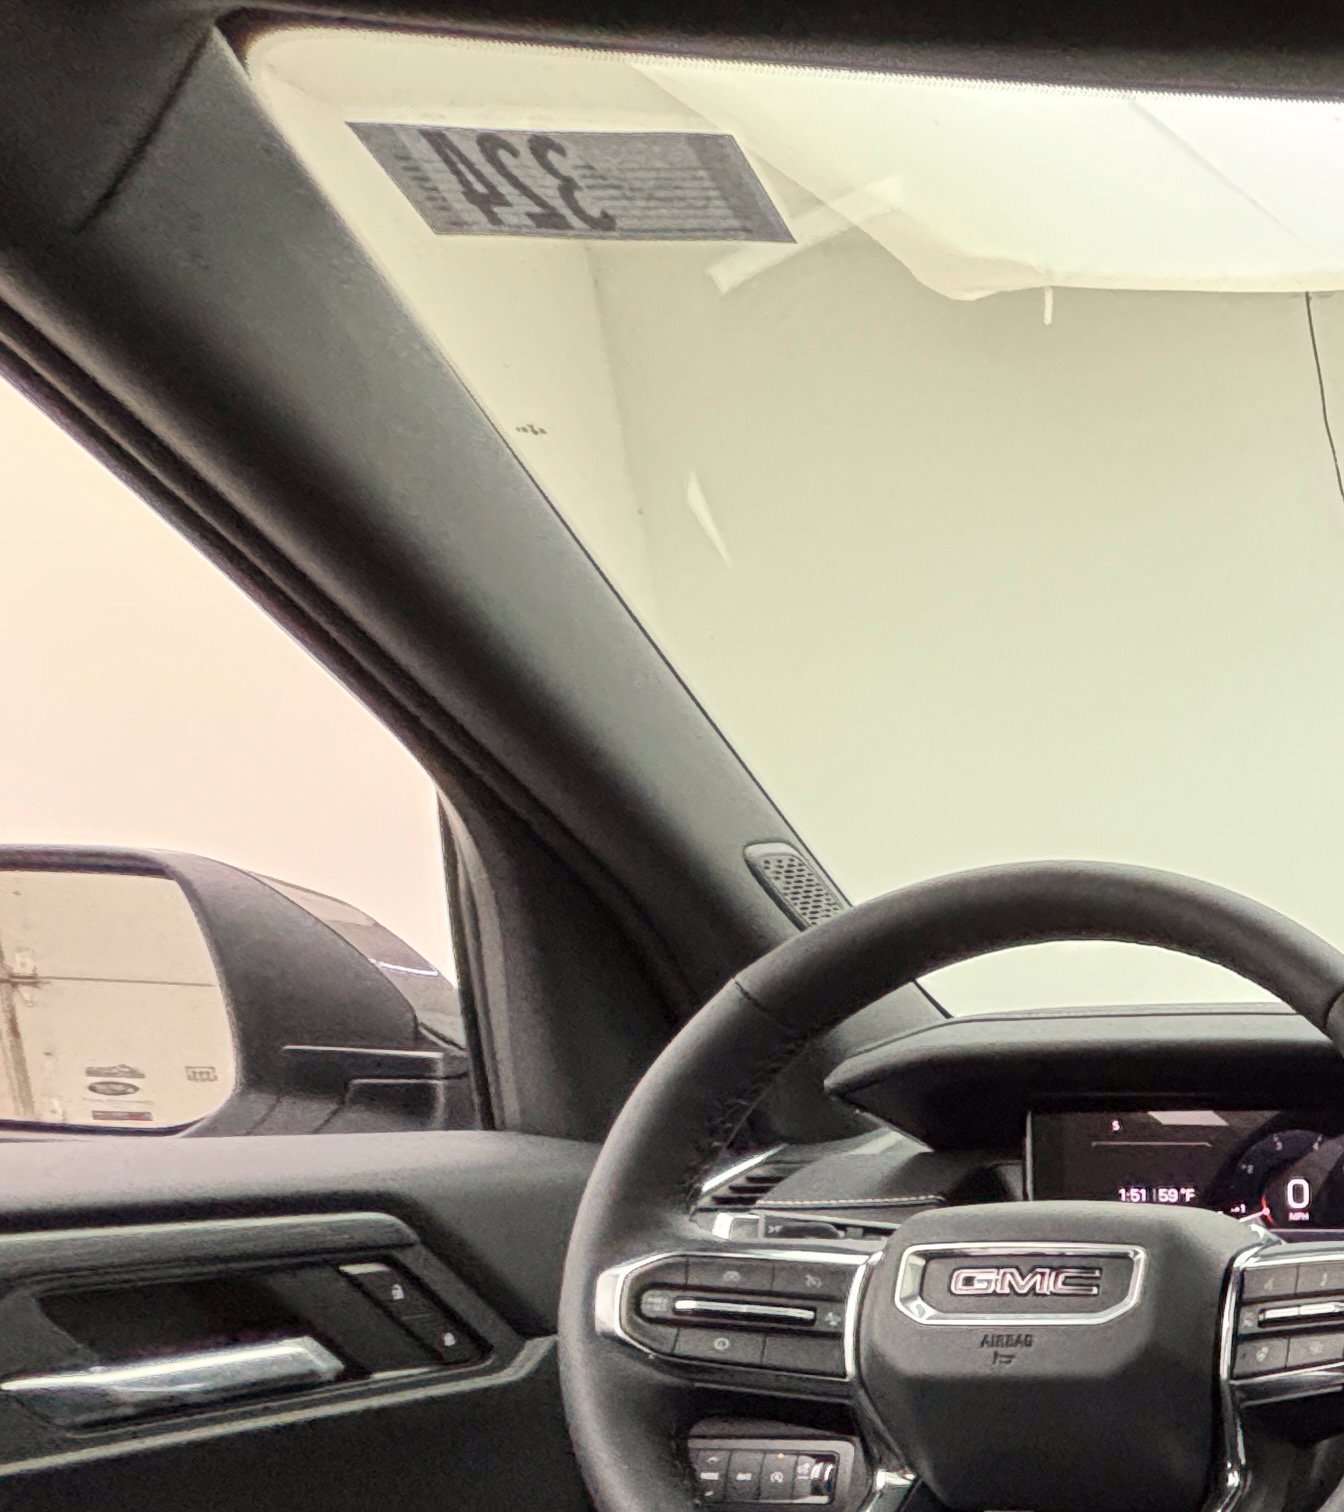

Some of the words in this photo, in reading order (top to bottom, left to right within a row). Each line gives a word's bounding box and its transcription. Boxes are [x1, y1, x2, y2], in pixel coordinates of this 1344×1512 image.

[1118, 1188, 1147, 1202] 1:51
[1286, 1178, 1310, 1209] 0
[1288, 1212, 1310, 1221] MPH
[949, 1266, 1101, 1296] GMC
[980, 1334, 1034, 1348] AIRBAG
